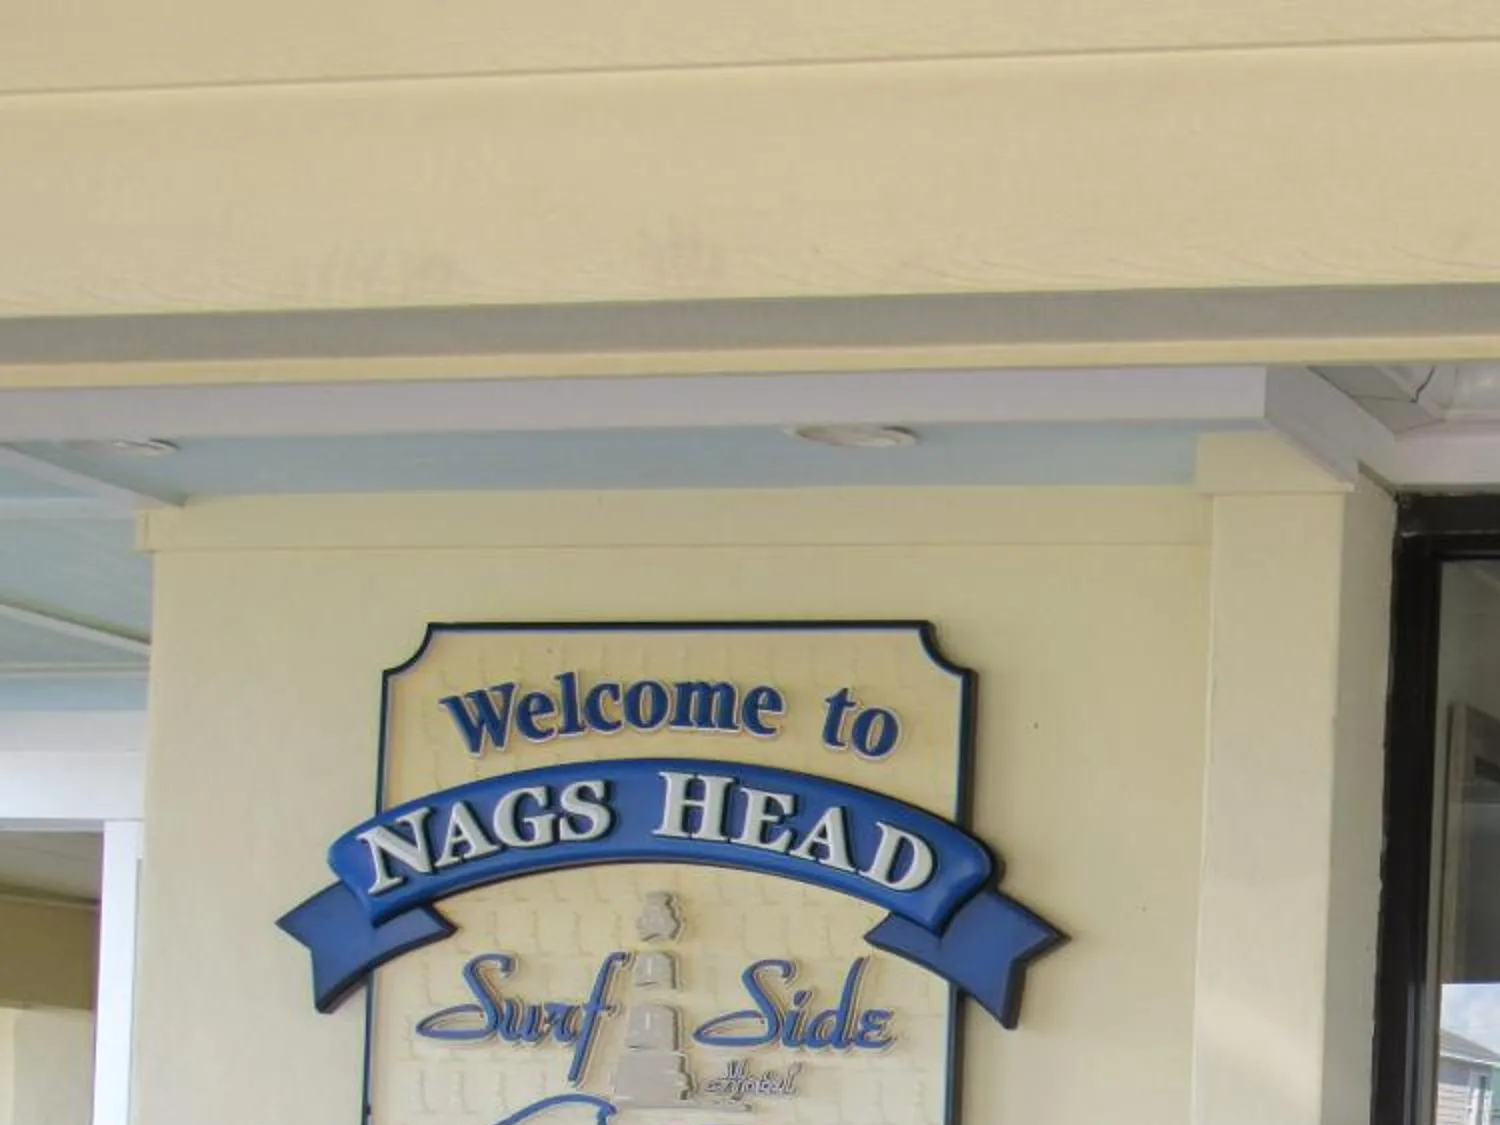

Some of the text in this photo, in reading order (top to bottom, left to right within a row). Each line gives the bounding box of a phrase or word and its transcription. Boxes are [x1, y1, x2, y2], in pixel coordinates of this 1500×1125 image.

[440, 670, 900, 760] Welcome to
[357, 769, 936, 897] NAGS HEAD
[415, 952, 896, 1084] Surf Side
